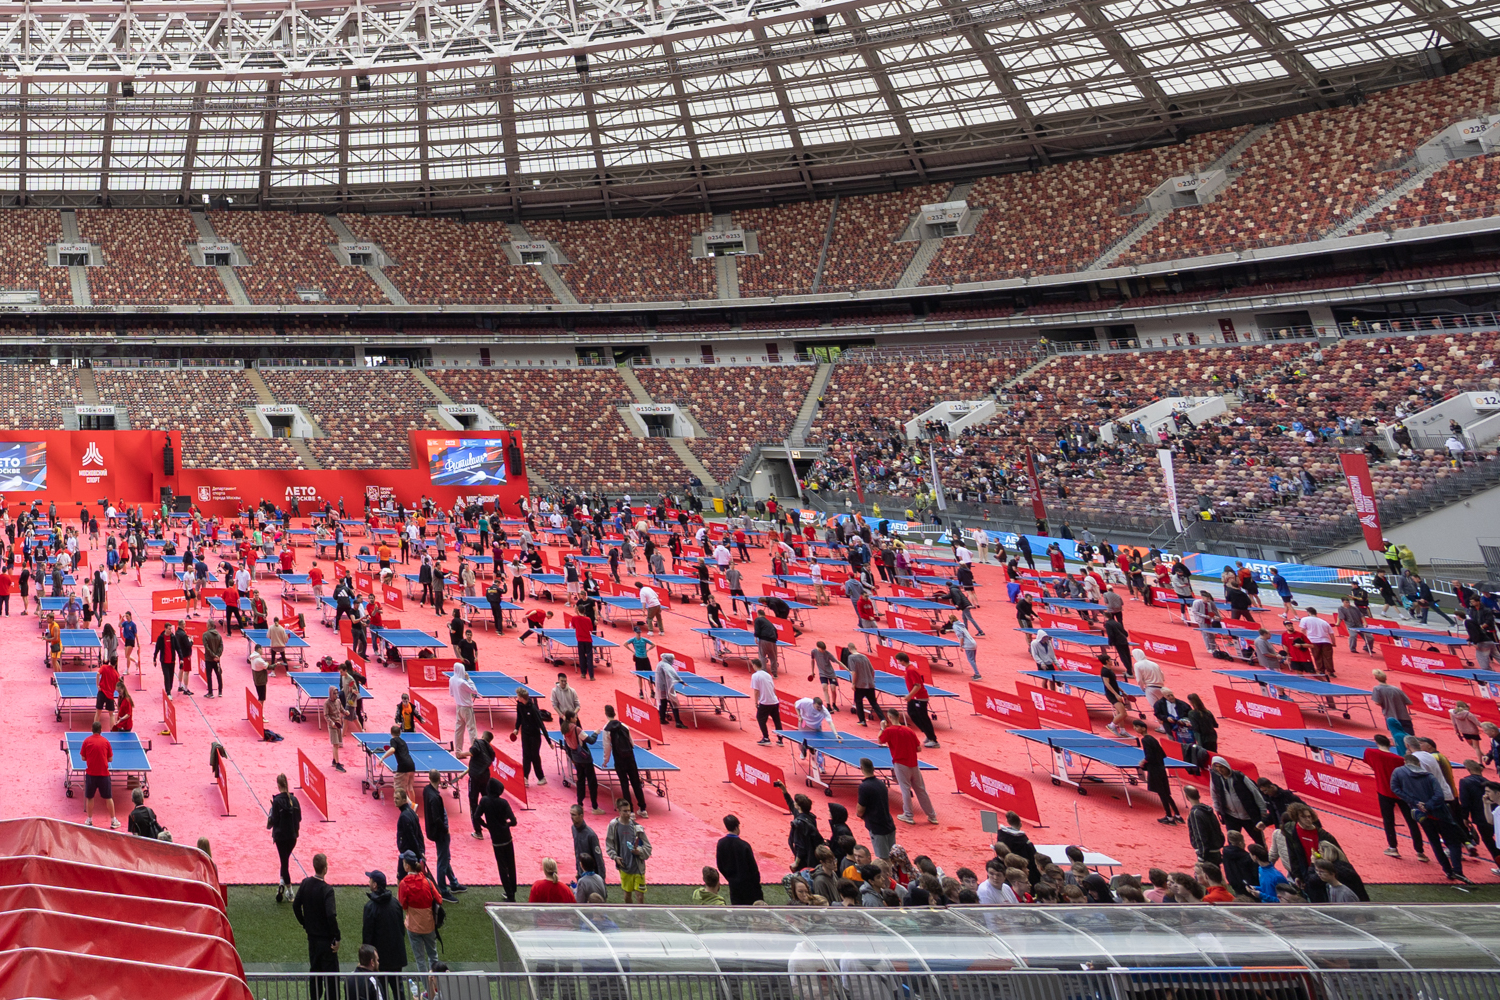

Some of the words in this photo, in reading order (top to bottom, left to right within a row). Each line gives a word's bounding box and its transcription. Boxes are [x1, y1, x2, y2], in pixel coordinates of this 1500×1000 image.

[1469, 124, 1487, 134] 228
[285, 486, 316, 496] ЛЕТО
[1347, 475, 1365, 513] МОСКОВСКИЙ
[1362, 495, 1375, 513] СПОРТ
[1246, 701, 1282, 716] МОСКОВСКИЙ
[1248, 708, 1265, 720] СПОРТ
[980, 774, 1016, 796] МОСКОВСКИЙ
[1317, 772, 1361, 793] МОСКОВСКИЙ
[1320, 781, 1340, 796] СПОРТ
[982, 783, 999, 798] СПОРТ
